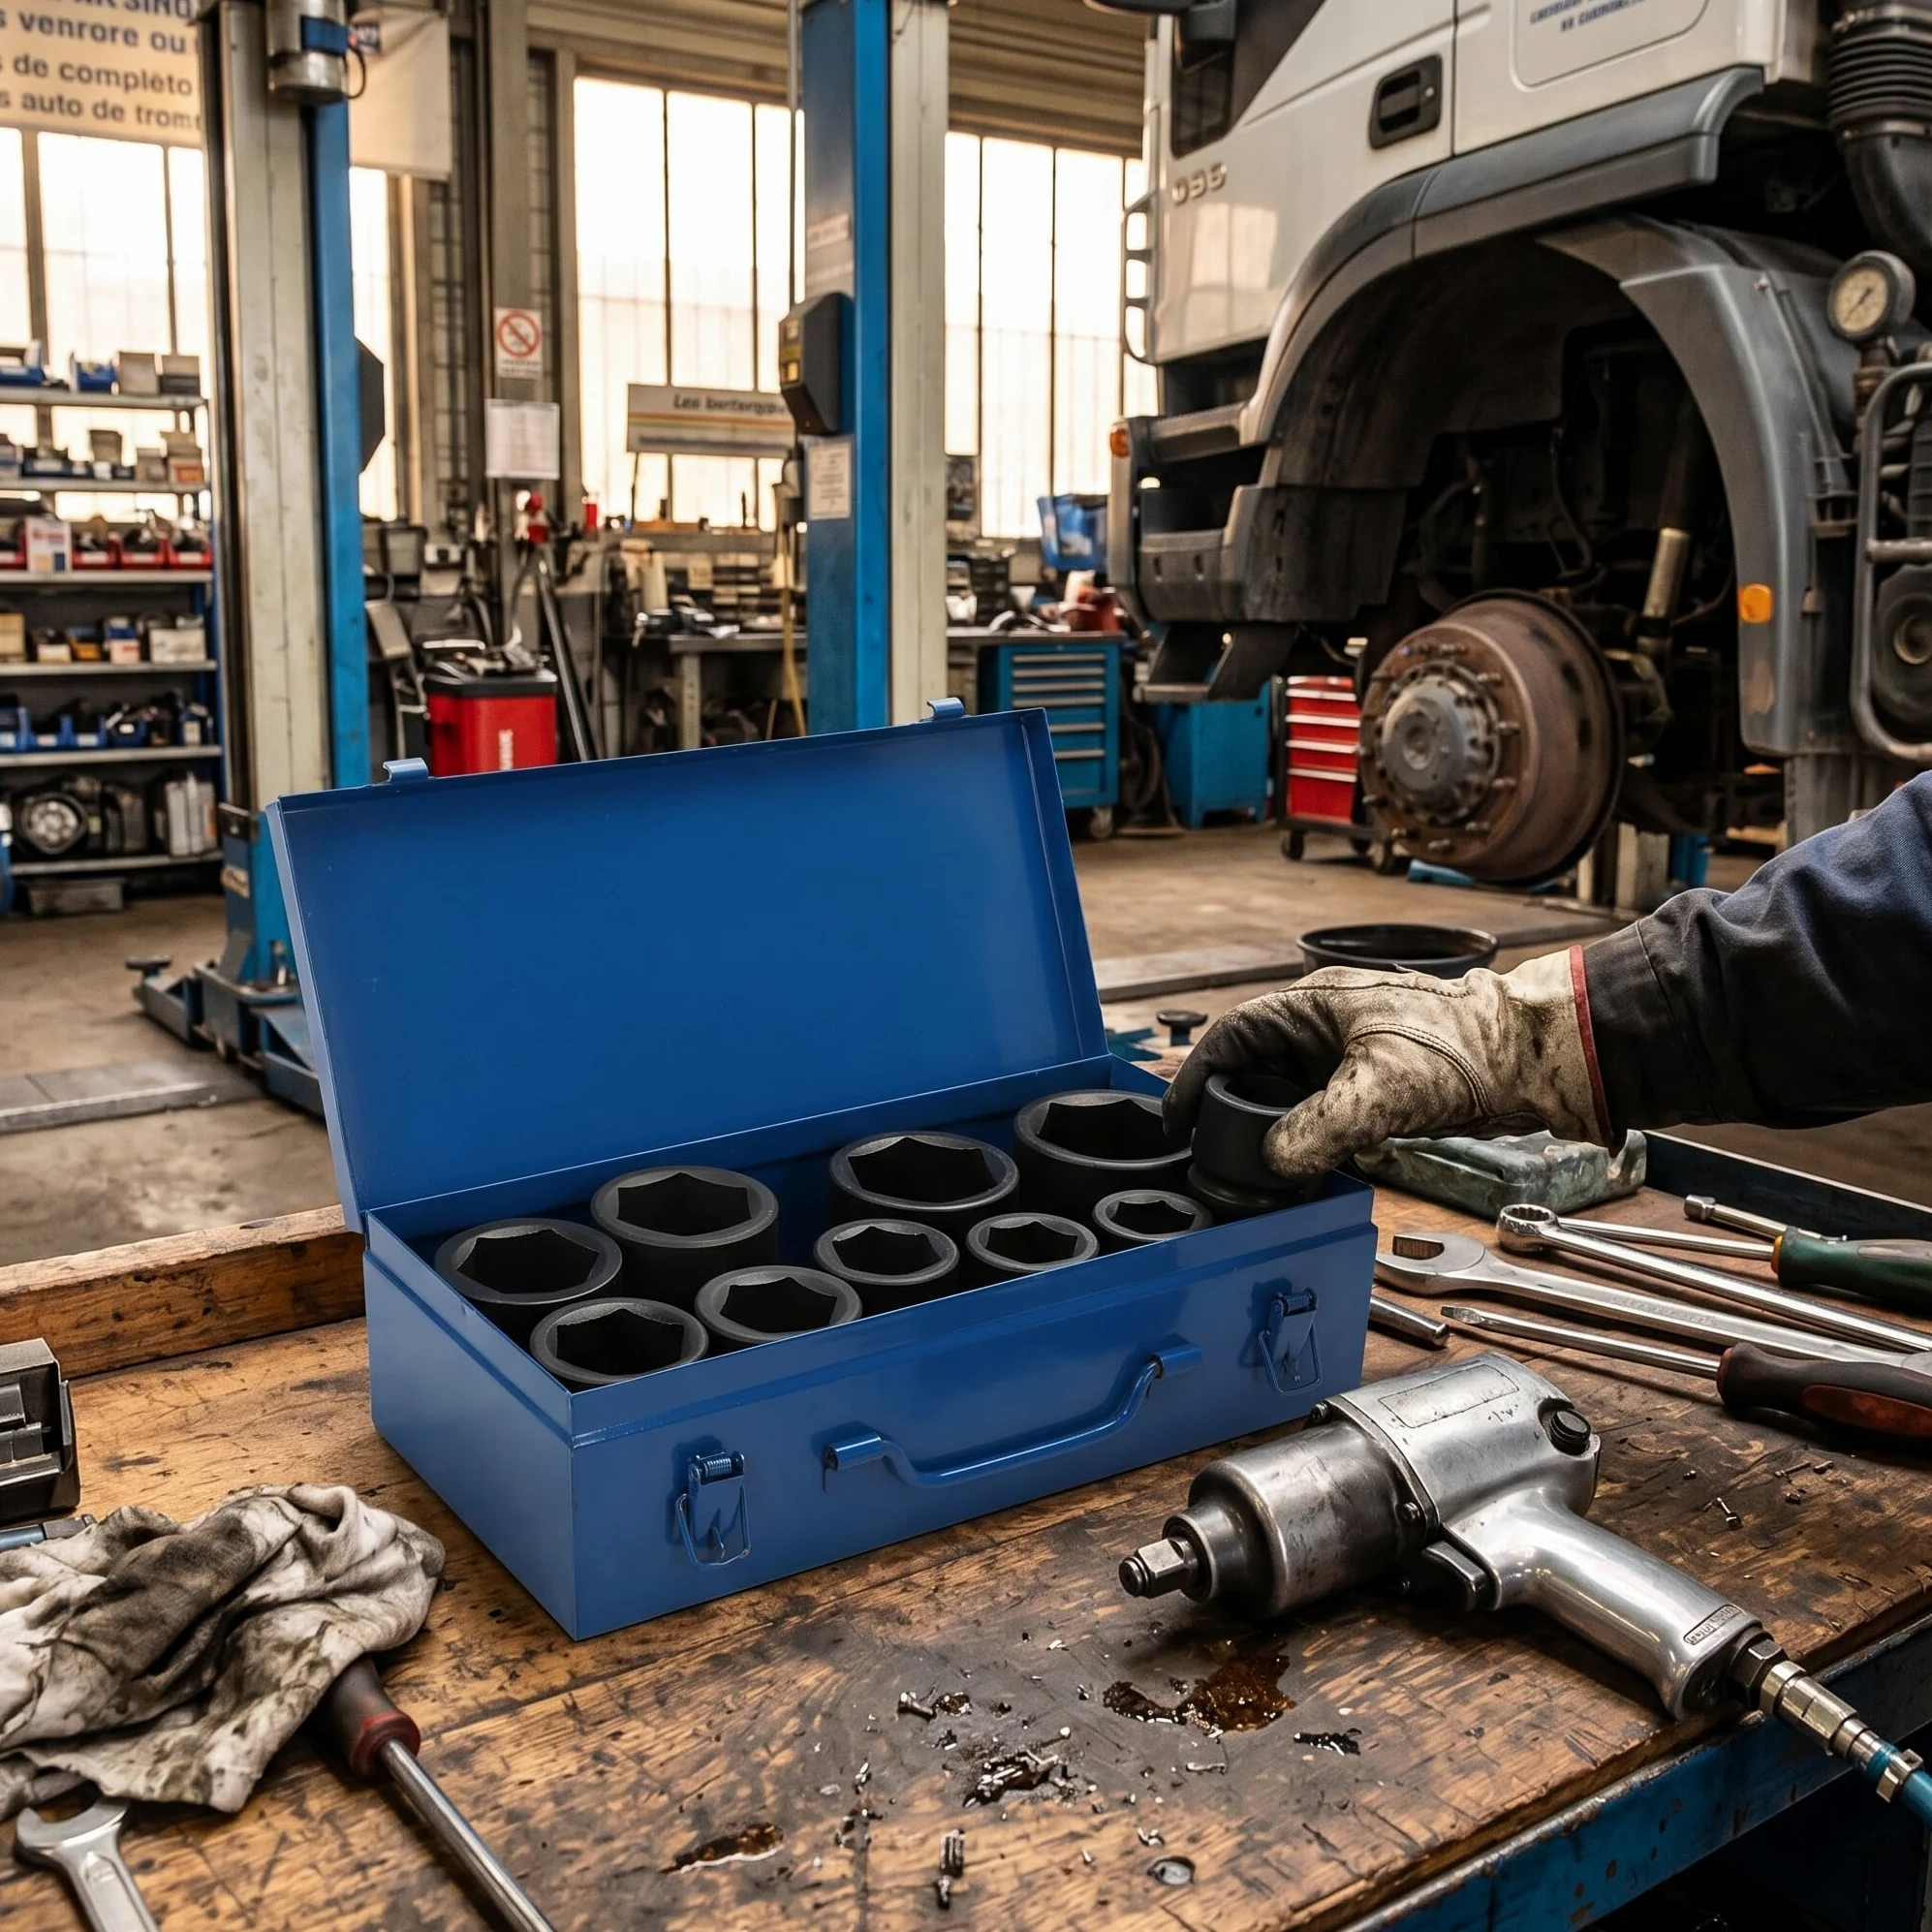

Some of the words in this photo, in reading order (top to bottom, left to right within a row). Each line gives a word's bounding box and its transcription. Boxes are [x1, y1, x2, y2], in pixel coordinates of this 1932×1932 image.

[149, 30, 186, 54] ou
[13, 53, 49, 78] de
[21, 92, 83, 117] auto
[92, 99, 126, 123] de
